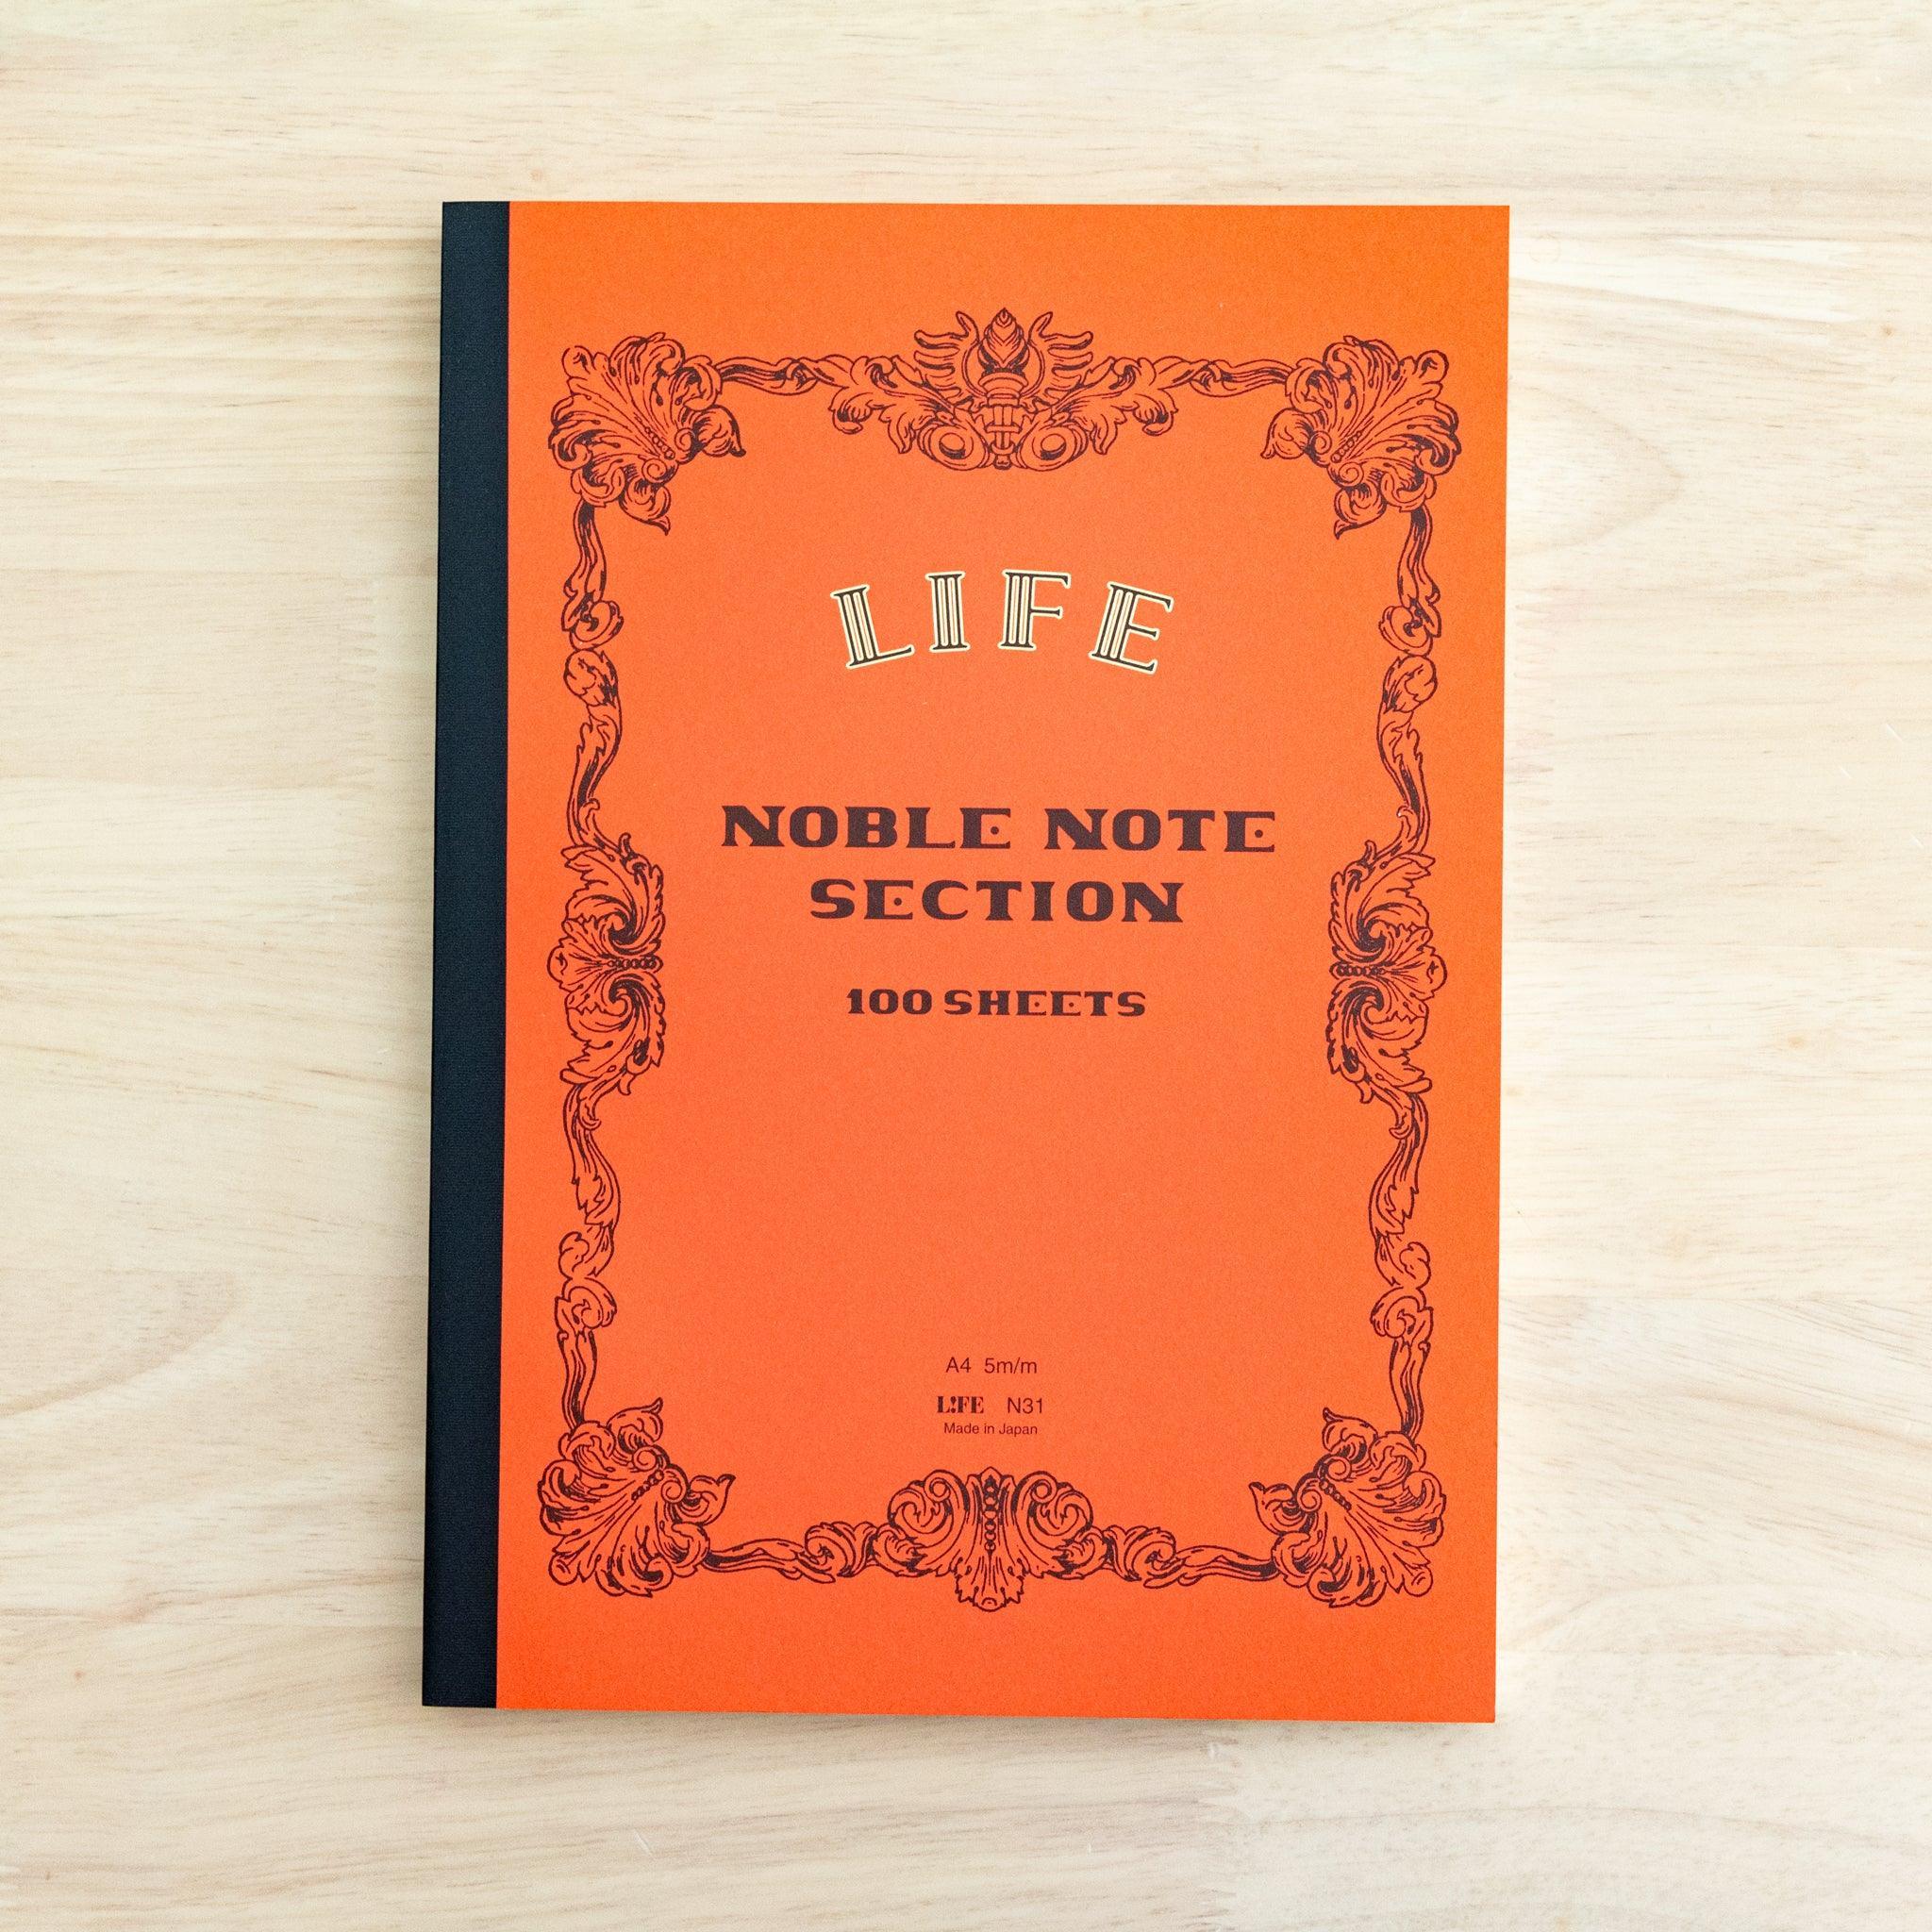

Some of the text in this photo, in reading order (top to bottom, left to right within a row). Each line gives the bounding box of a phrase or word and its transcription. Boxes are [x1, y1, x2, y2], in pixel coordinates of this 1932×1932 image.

[830, 569, 1174, 674] LIFE
[722, 806, 1275, 852] NOBLE NOTE
[810, 878, 1184, 923] SECTION
[847, 989, 1146, 1017] 100 SHEETS
[945, 1357, 1038, 1374] A4 5m/m
[1007, 1396, 1043, 1414] N31
[943, 1422, 1038, 1438] Made in Japan
